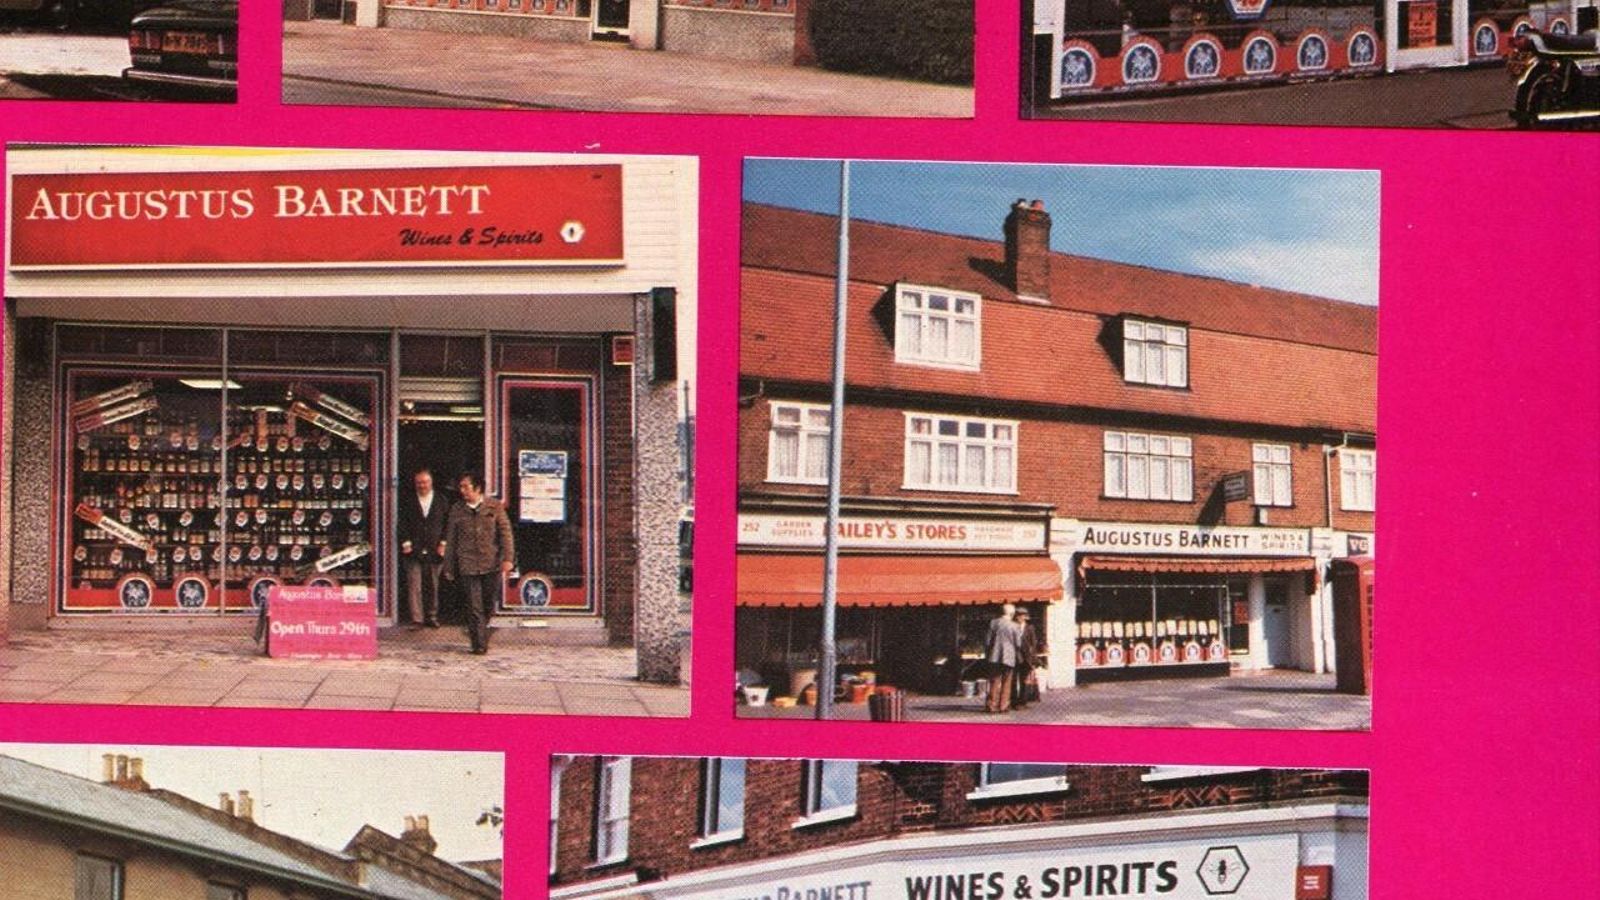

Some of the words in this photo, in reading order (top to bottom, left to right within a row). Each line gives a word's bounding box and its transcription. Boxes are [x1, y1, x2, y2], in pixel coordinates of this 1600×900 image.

[400, 228, 452, 246] Wines
[458, 228, 474, 245] &
[479, 226, 543, 248] Spirits
[905, 524, 967, 540] STORES
[271, 621, 304, 637] Open
[307, 621, 336, 635] Thurs
[339, 621, 371, 635] 29th
[905, 871, 1004, 900] WINES
[1014, 875, 1032, 899] &
[1041, 860, 1178, 898] SPIRITS
